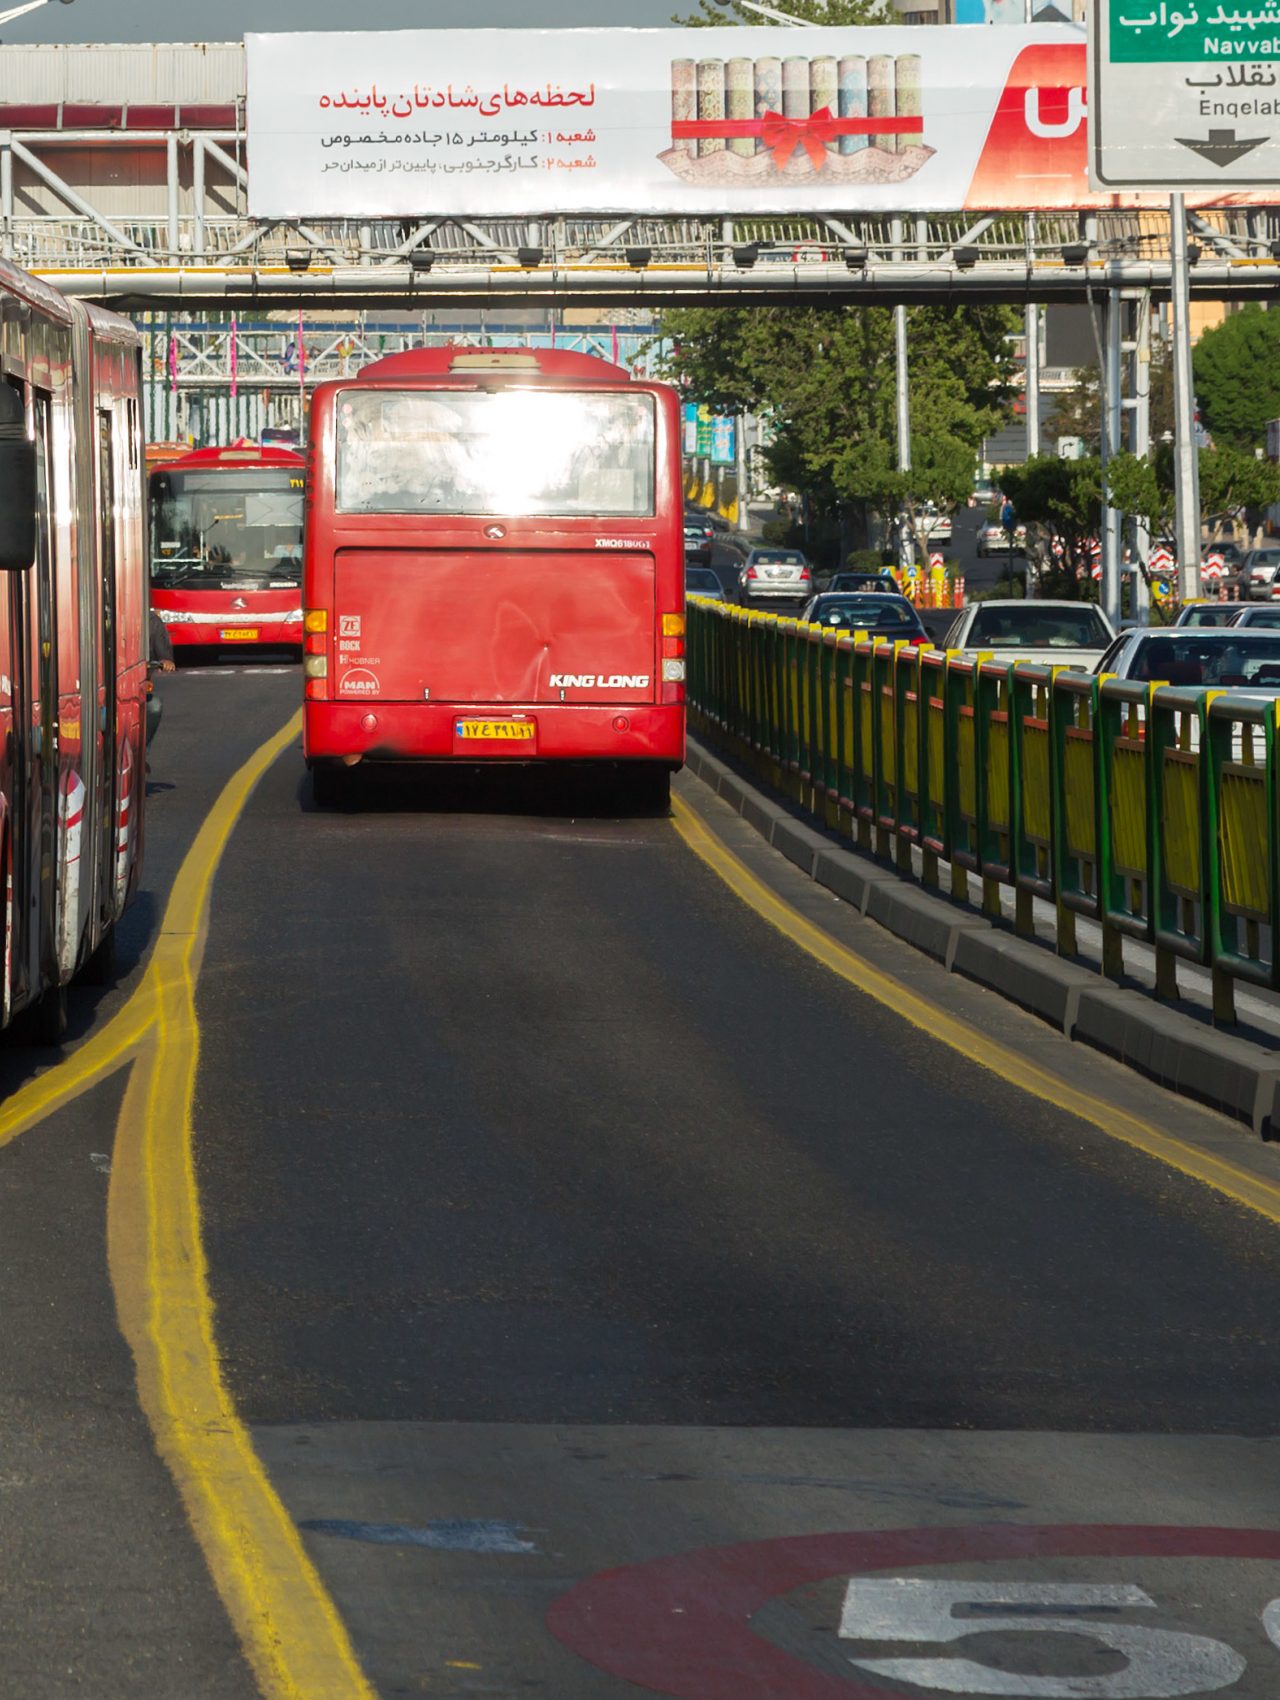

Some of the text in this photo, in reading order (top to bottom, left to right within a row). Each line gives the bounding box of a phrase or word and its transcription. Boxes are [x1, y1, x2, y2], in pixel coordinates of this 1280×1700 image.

[1119, 2, 1199, 38] نواب
[1185, 64, 1277, 95] نقلاب
[319, 85, 388, 118] پاینده
[392, 84, 478, 118] شادتان
[320, 131, 404, 148] مخصوص
[404, 131, 443, 148] جاده
[446, 131, 464, 146] ۱۵
[467, 130, 538, 147] کیلومتر
[556, 128, 596, 146] شعبه
[556, 155, 596, 171] شعبه
[344, 681, 376, 690] MAN
[549, 674, 650, 688] KING LONG
[838, 1577, 1280, 1699] 5
